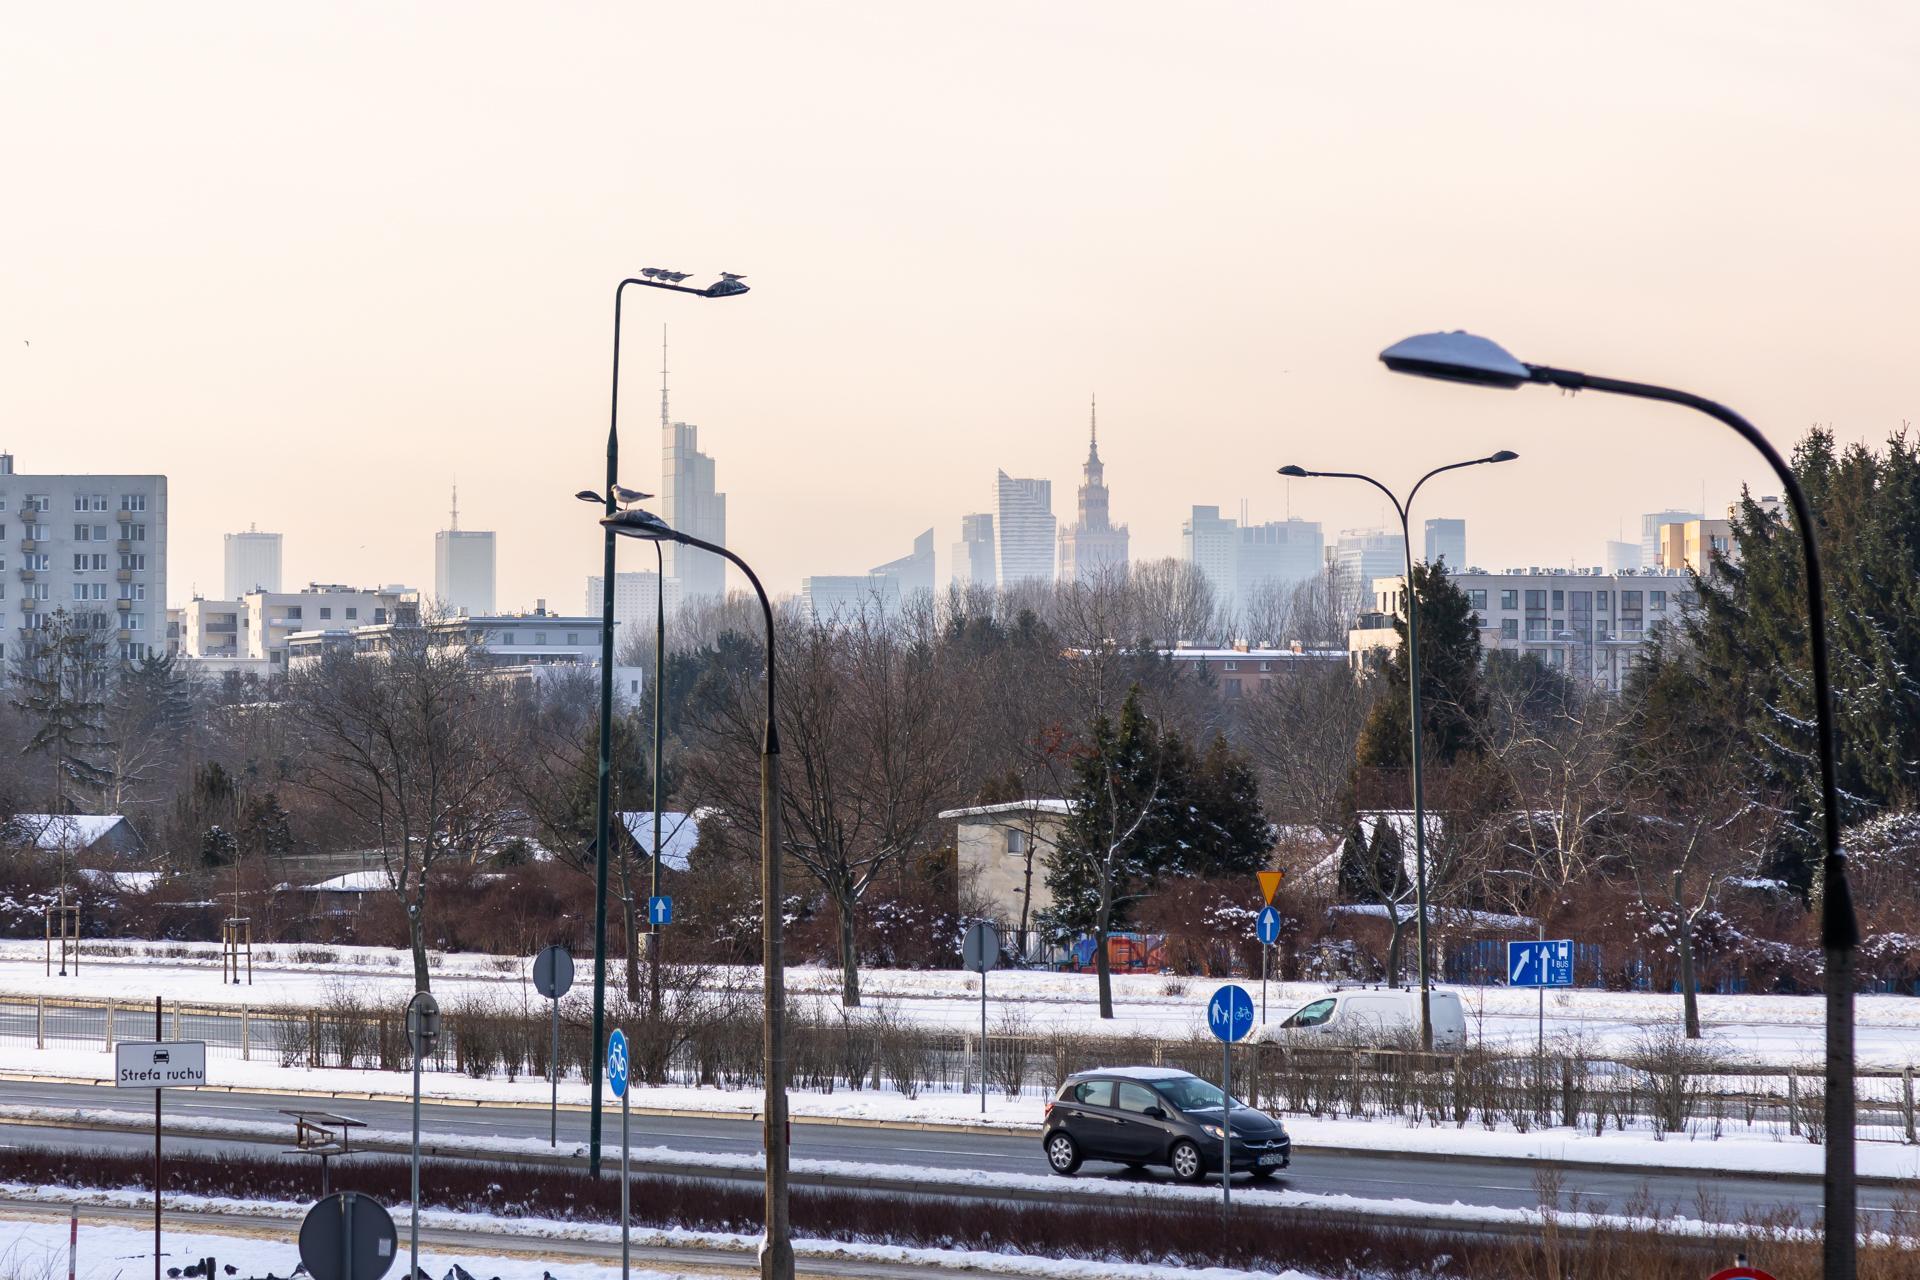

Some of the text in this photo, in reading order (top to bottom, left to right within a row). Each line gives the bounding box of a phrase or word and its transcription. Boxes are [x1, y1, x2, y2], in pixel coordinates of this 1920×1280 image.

[1556, 960, 1569, 968] BUS
[120, 1067, 203, 1081] Strefa ruchu
